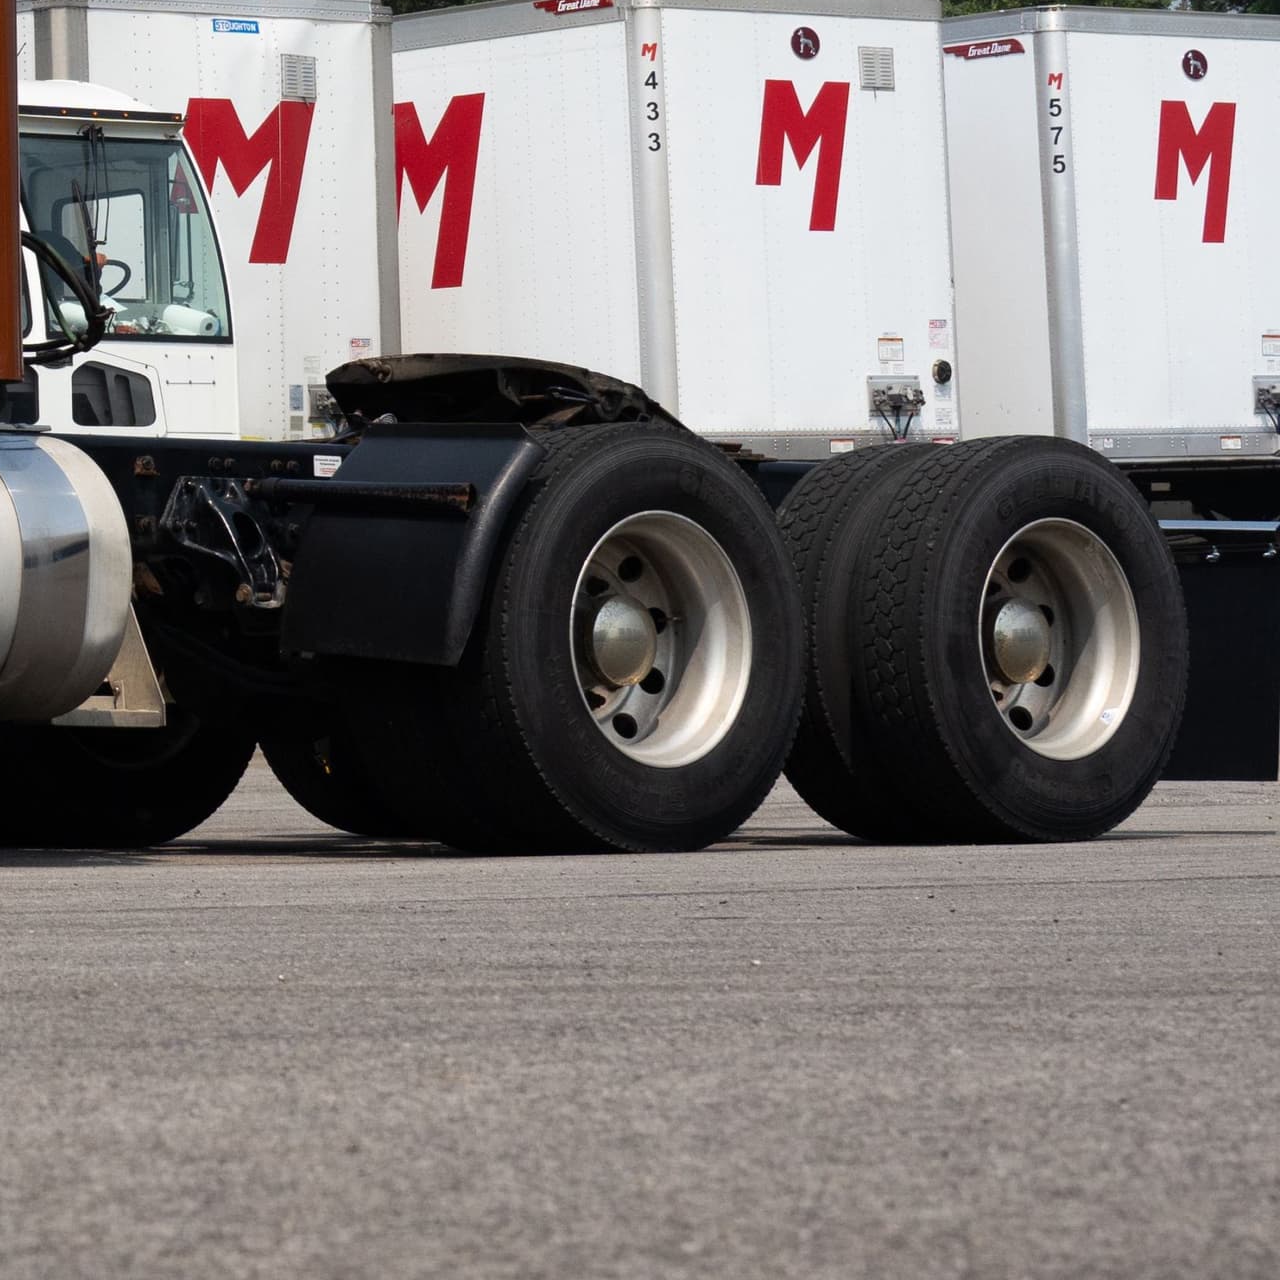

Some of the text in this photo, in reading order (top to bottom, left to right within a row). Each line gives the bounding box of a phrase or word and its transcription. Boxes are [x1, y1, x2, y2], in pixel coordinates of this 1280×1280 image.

[557, 0, 579, 12] Great
[968, 42, 1012, 57] Great Dane
[174, 98, 315, 265] M
[392, 93, 485, 290] M
[755, 79, 850, 232] M
[1154, 100, 1237, 244] M
